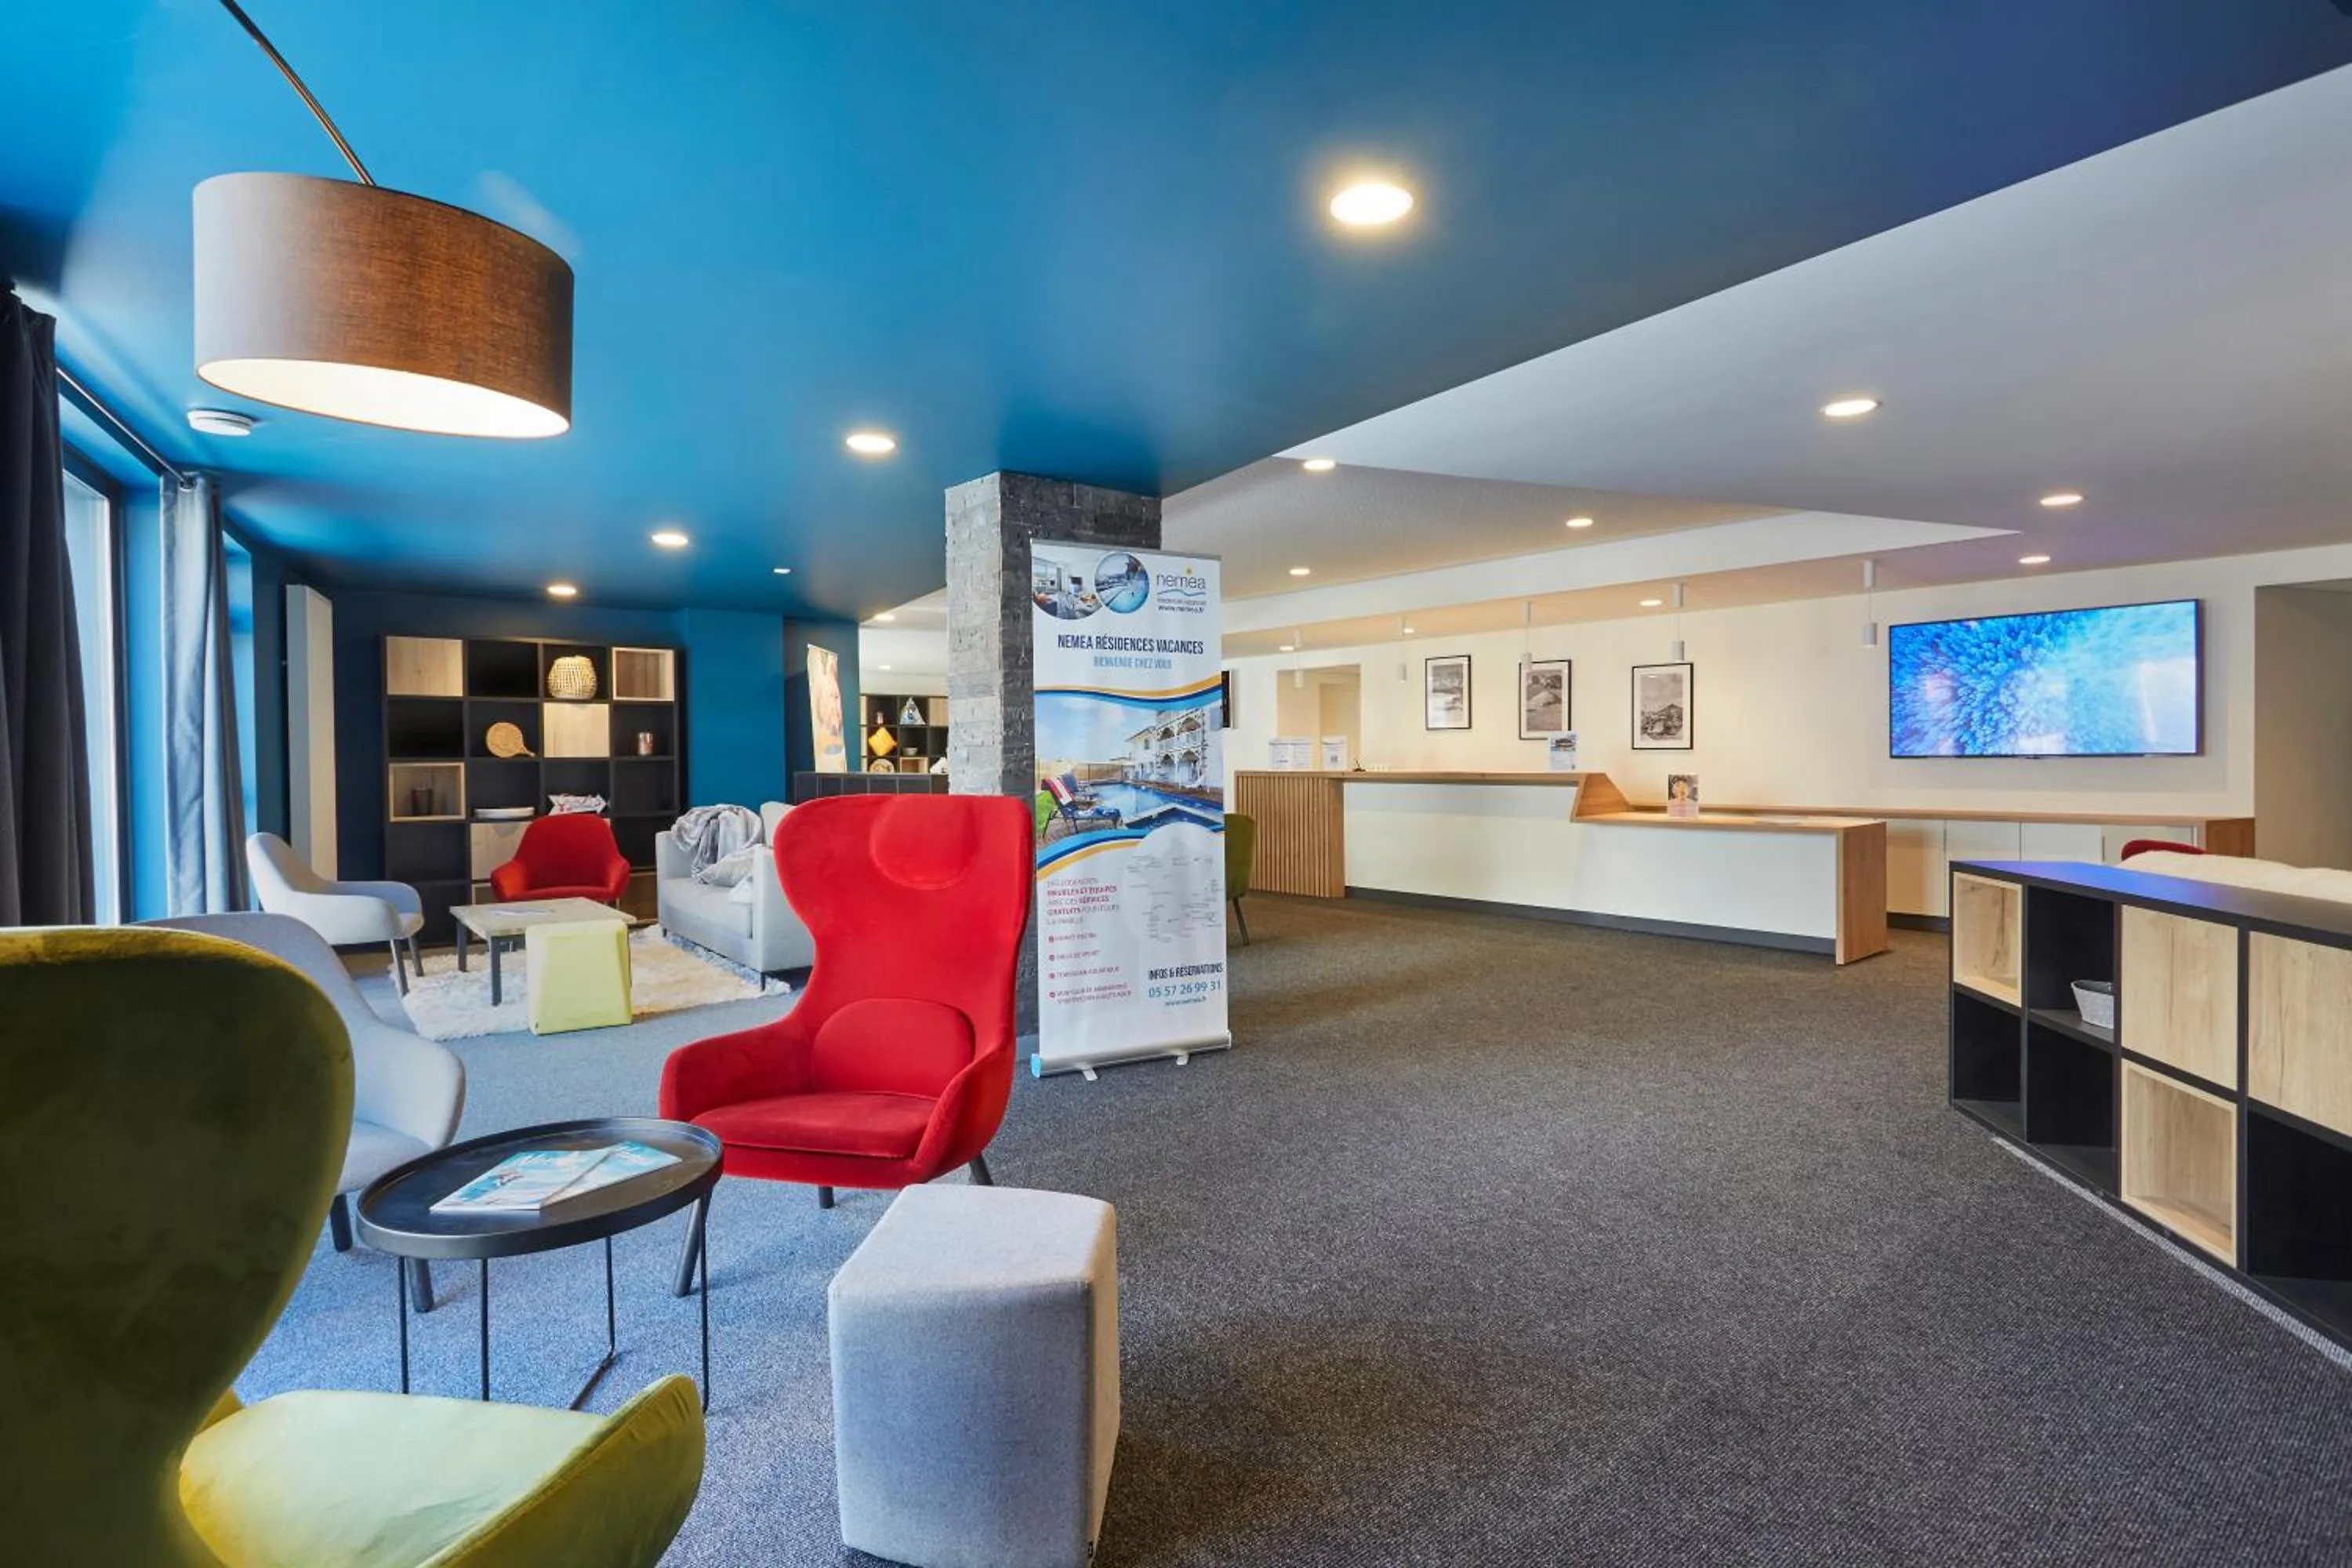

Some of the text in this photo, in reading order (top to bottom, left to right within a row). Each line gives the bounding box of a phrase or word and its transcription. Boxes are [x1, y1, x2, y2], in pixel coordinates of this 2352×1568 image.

[1058, 633, 1203, 655] NEMEA RÉSIDENCES VACANCES
[1149, 968, 1168, 980] INFOS
[1149, 980, 1221, 998] 05 57 26 99 31
